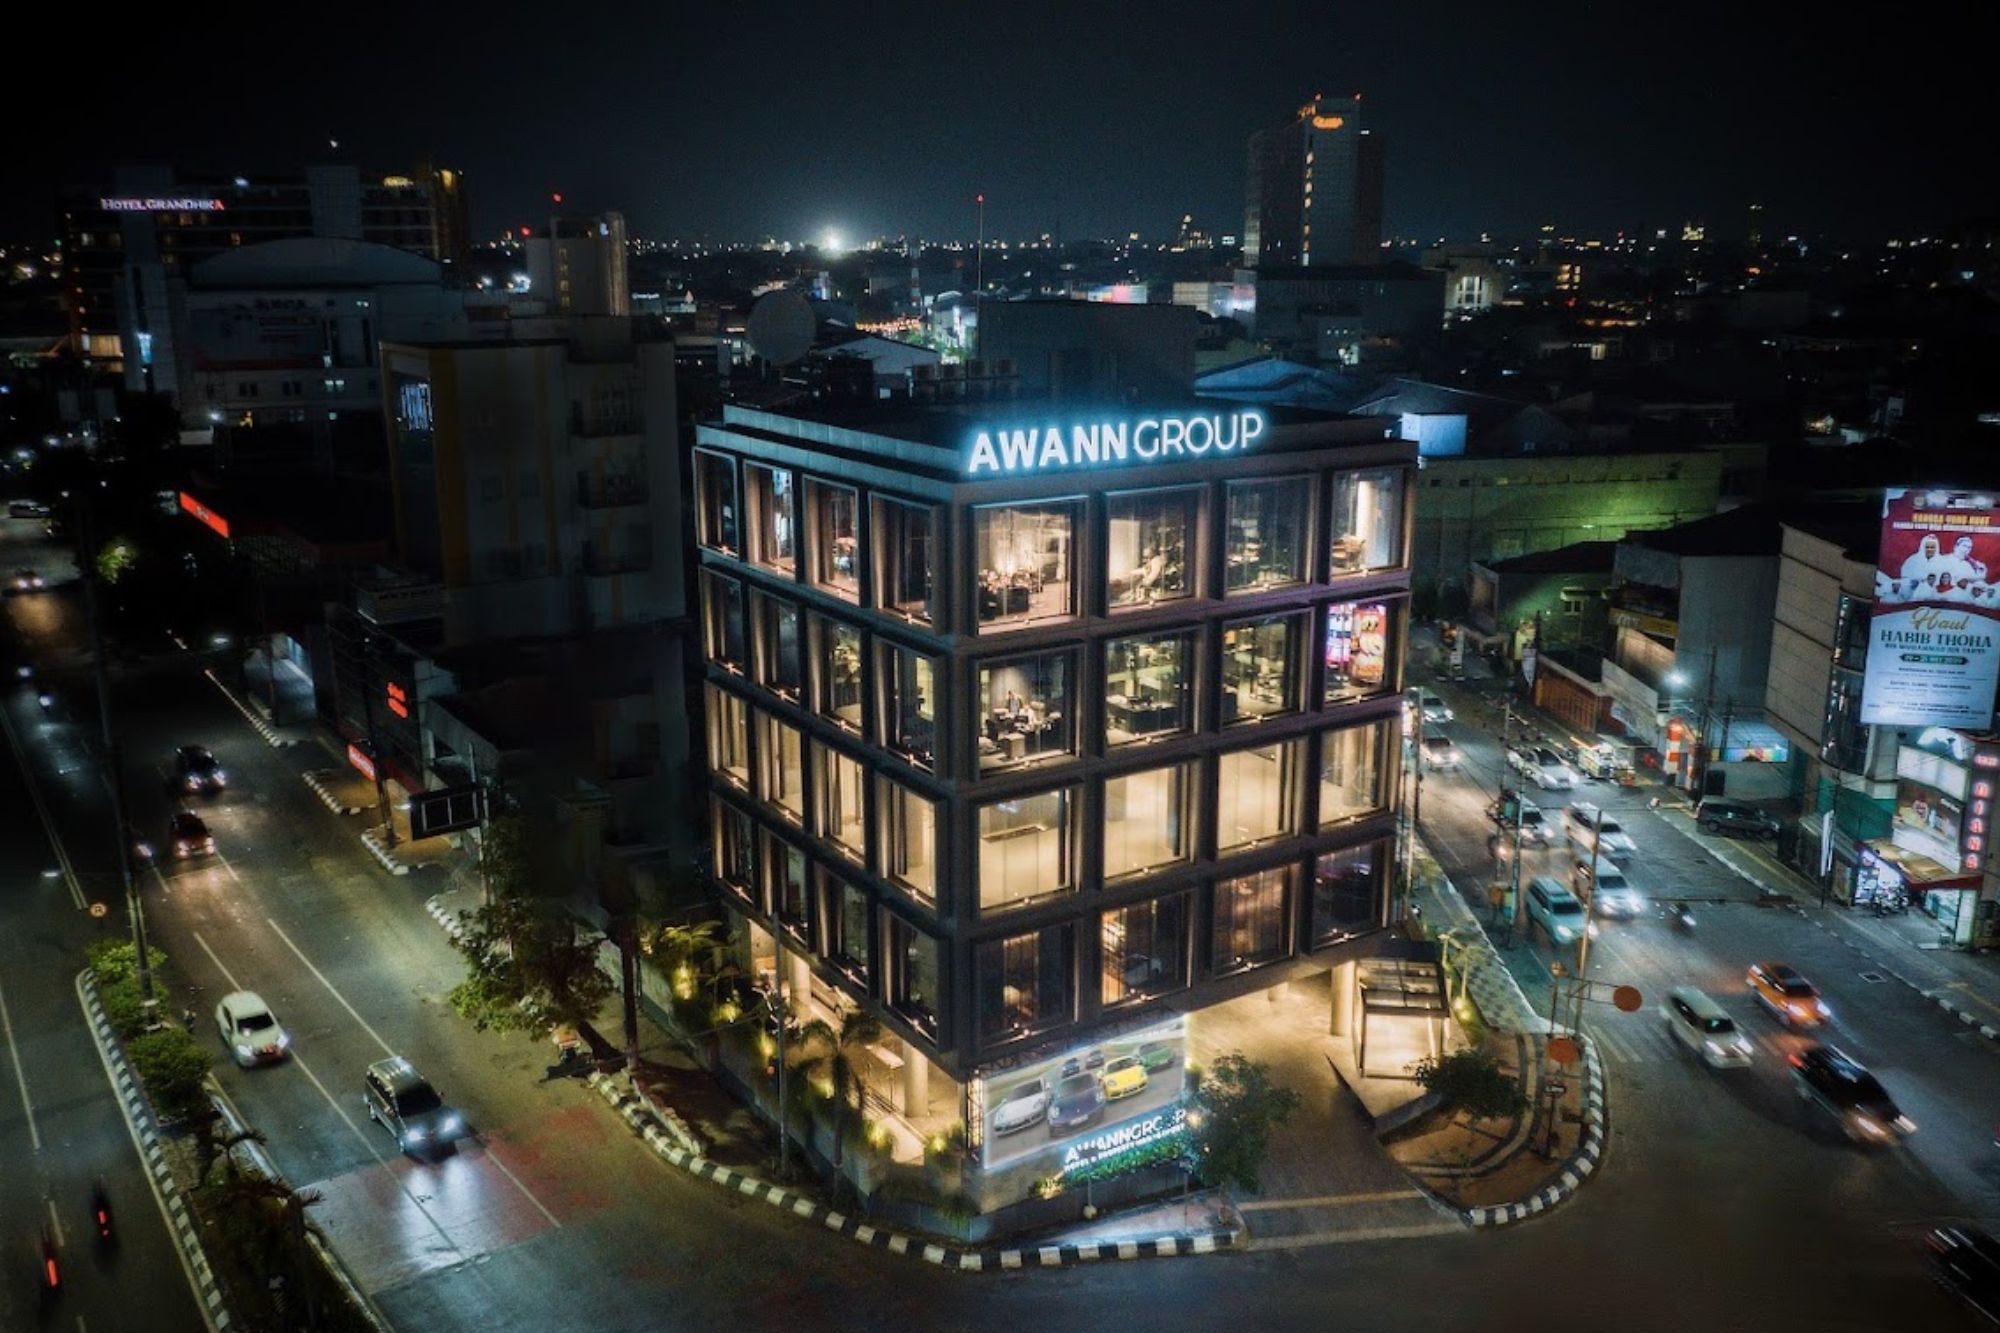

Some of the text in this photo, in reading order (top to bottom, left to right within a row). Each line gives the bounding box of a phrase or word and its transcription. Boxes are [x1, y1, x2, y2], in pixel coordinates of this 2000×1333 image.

[1911, 606, 1970, 630] Haul
[1881, 629, 1931, 644] HABIB
[1938, 633, 1992, 648] THOHA
